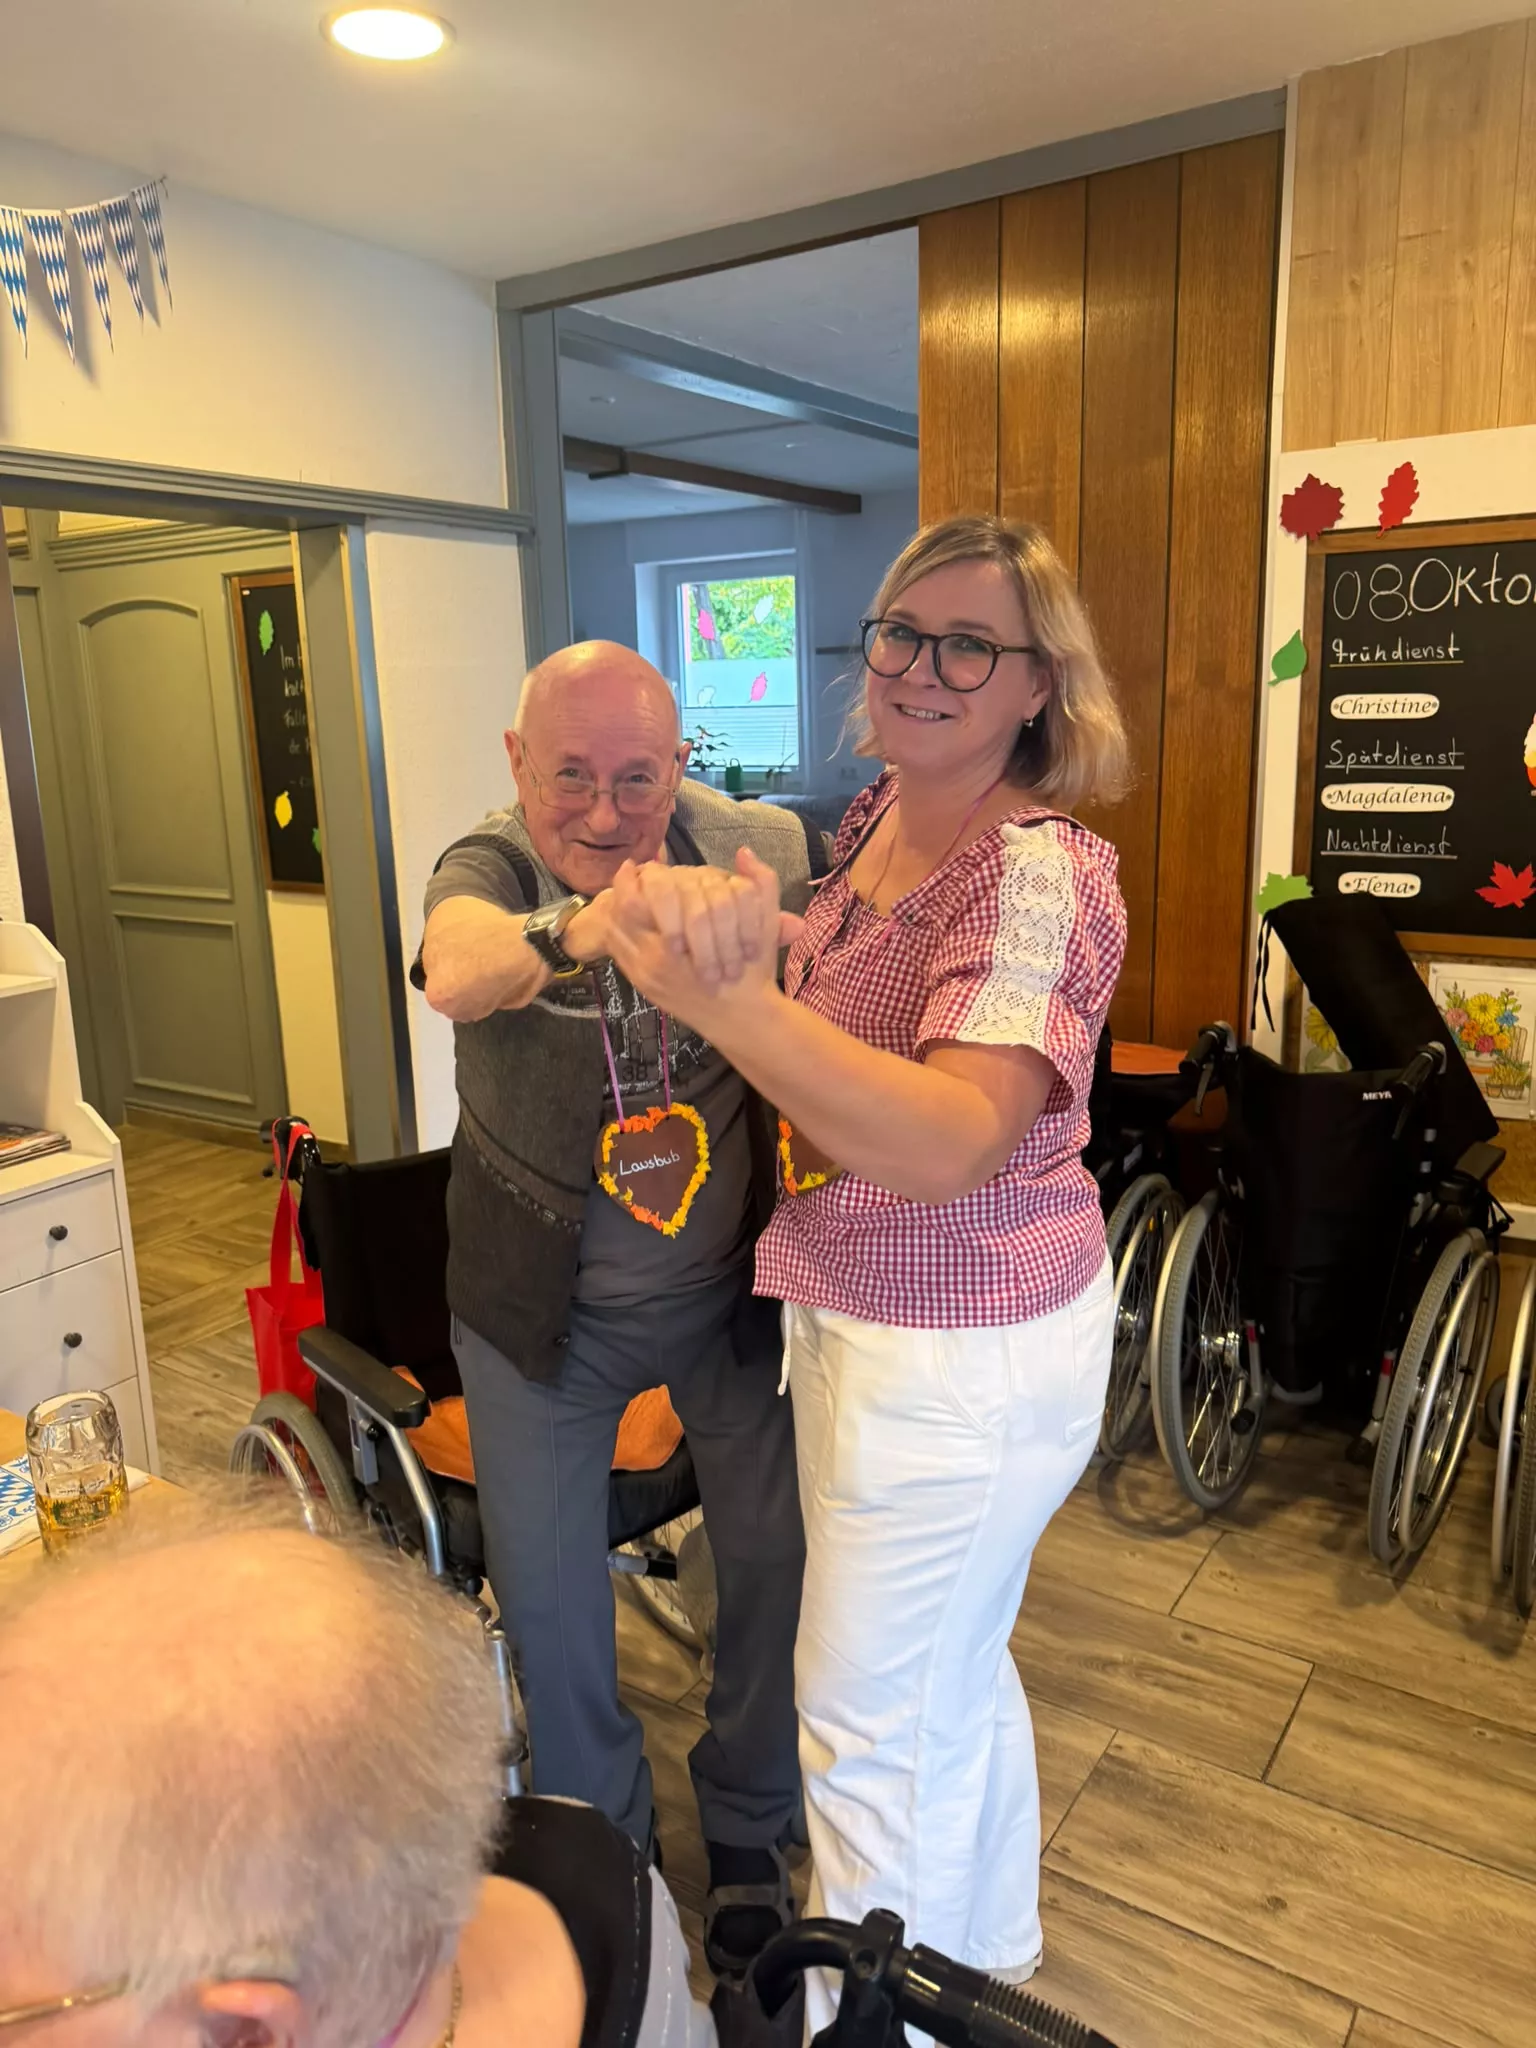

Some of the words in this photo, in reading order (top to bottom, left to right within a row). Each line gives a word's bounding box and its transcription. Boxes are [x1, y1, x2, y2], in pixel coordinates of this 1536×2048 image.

[1339, 696, 1432, 715] Christine
[1330, 786, 1447, 809] Magdalena
[1326, 826, 1452, 855] Nachtdienst
[1353, 877, 1410, 894] Elena
[619, 1150, 681, 1176] Lausbub
